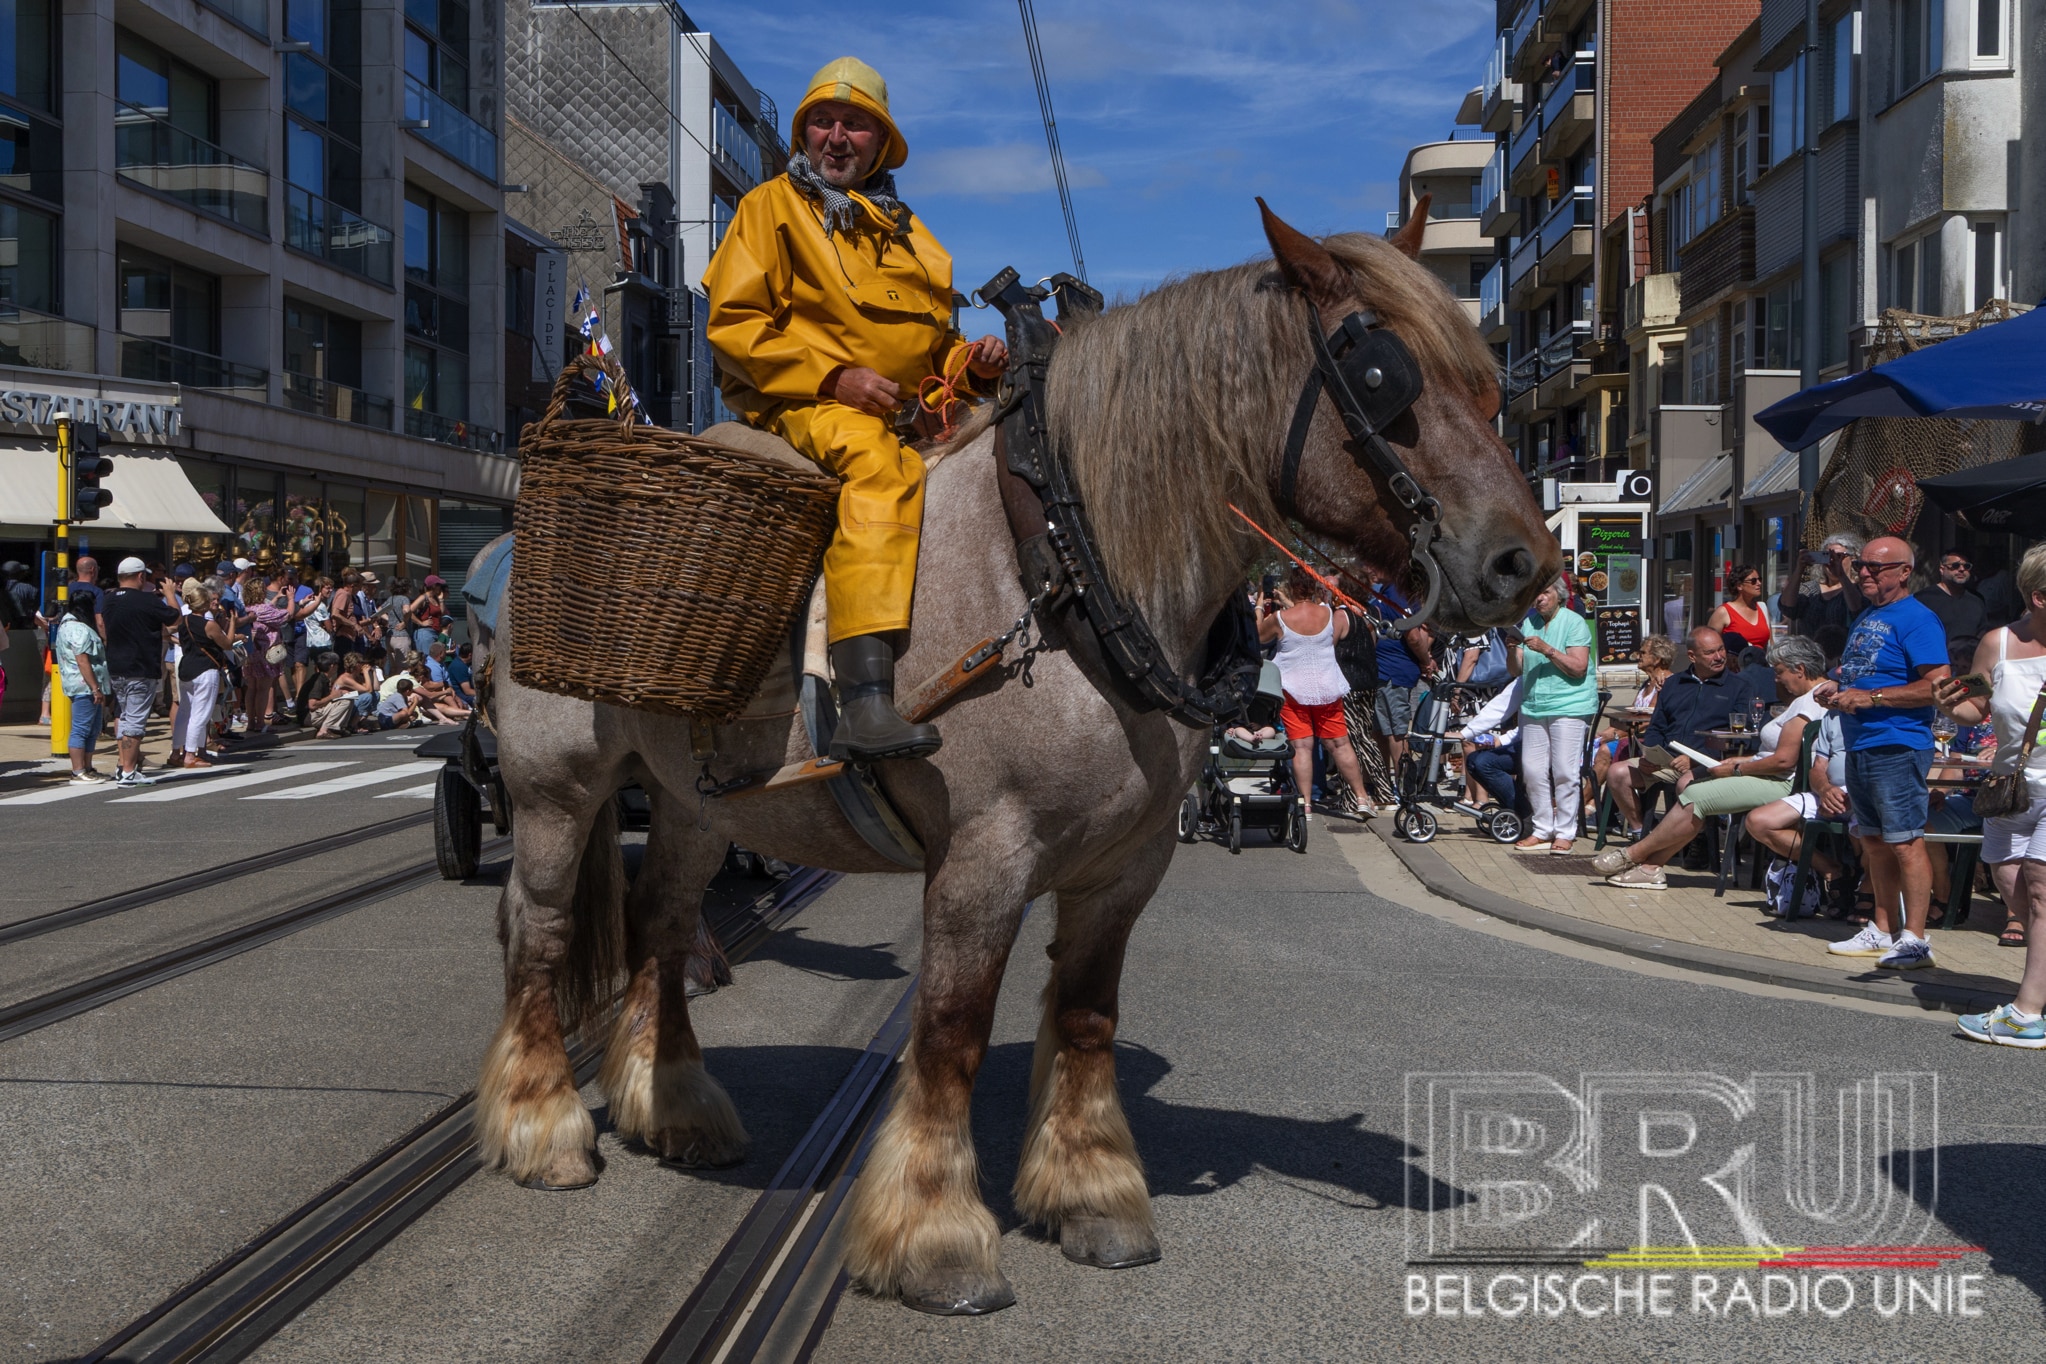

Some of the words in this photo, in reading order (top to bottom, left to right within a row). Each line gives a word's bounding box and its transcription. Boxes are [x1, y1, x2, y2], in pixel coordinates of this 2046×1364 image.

[545, 260, 556, 345] PLACIDE
[0, 390, 183, 436] STAURANT
[1591, 527, 1630, 541] Pizzeria
